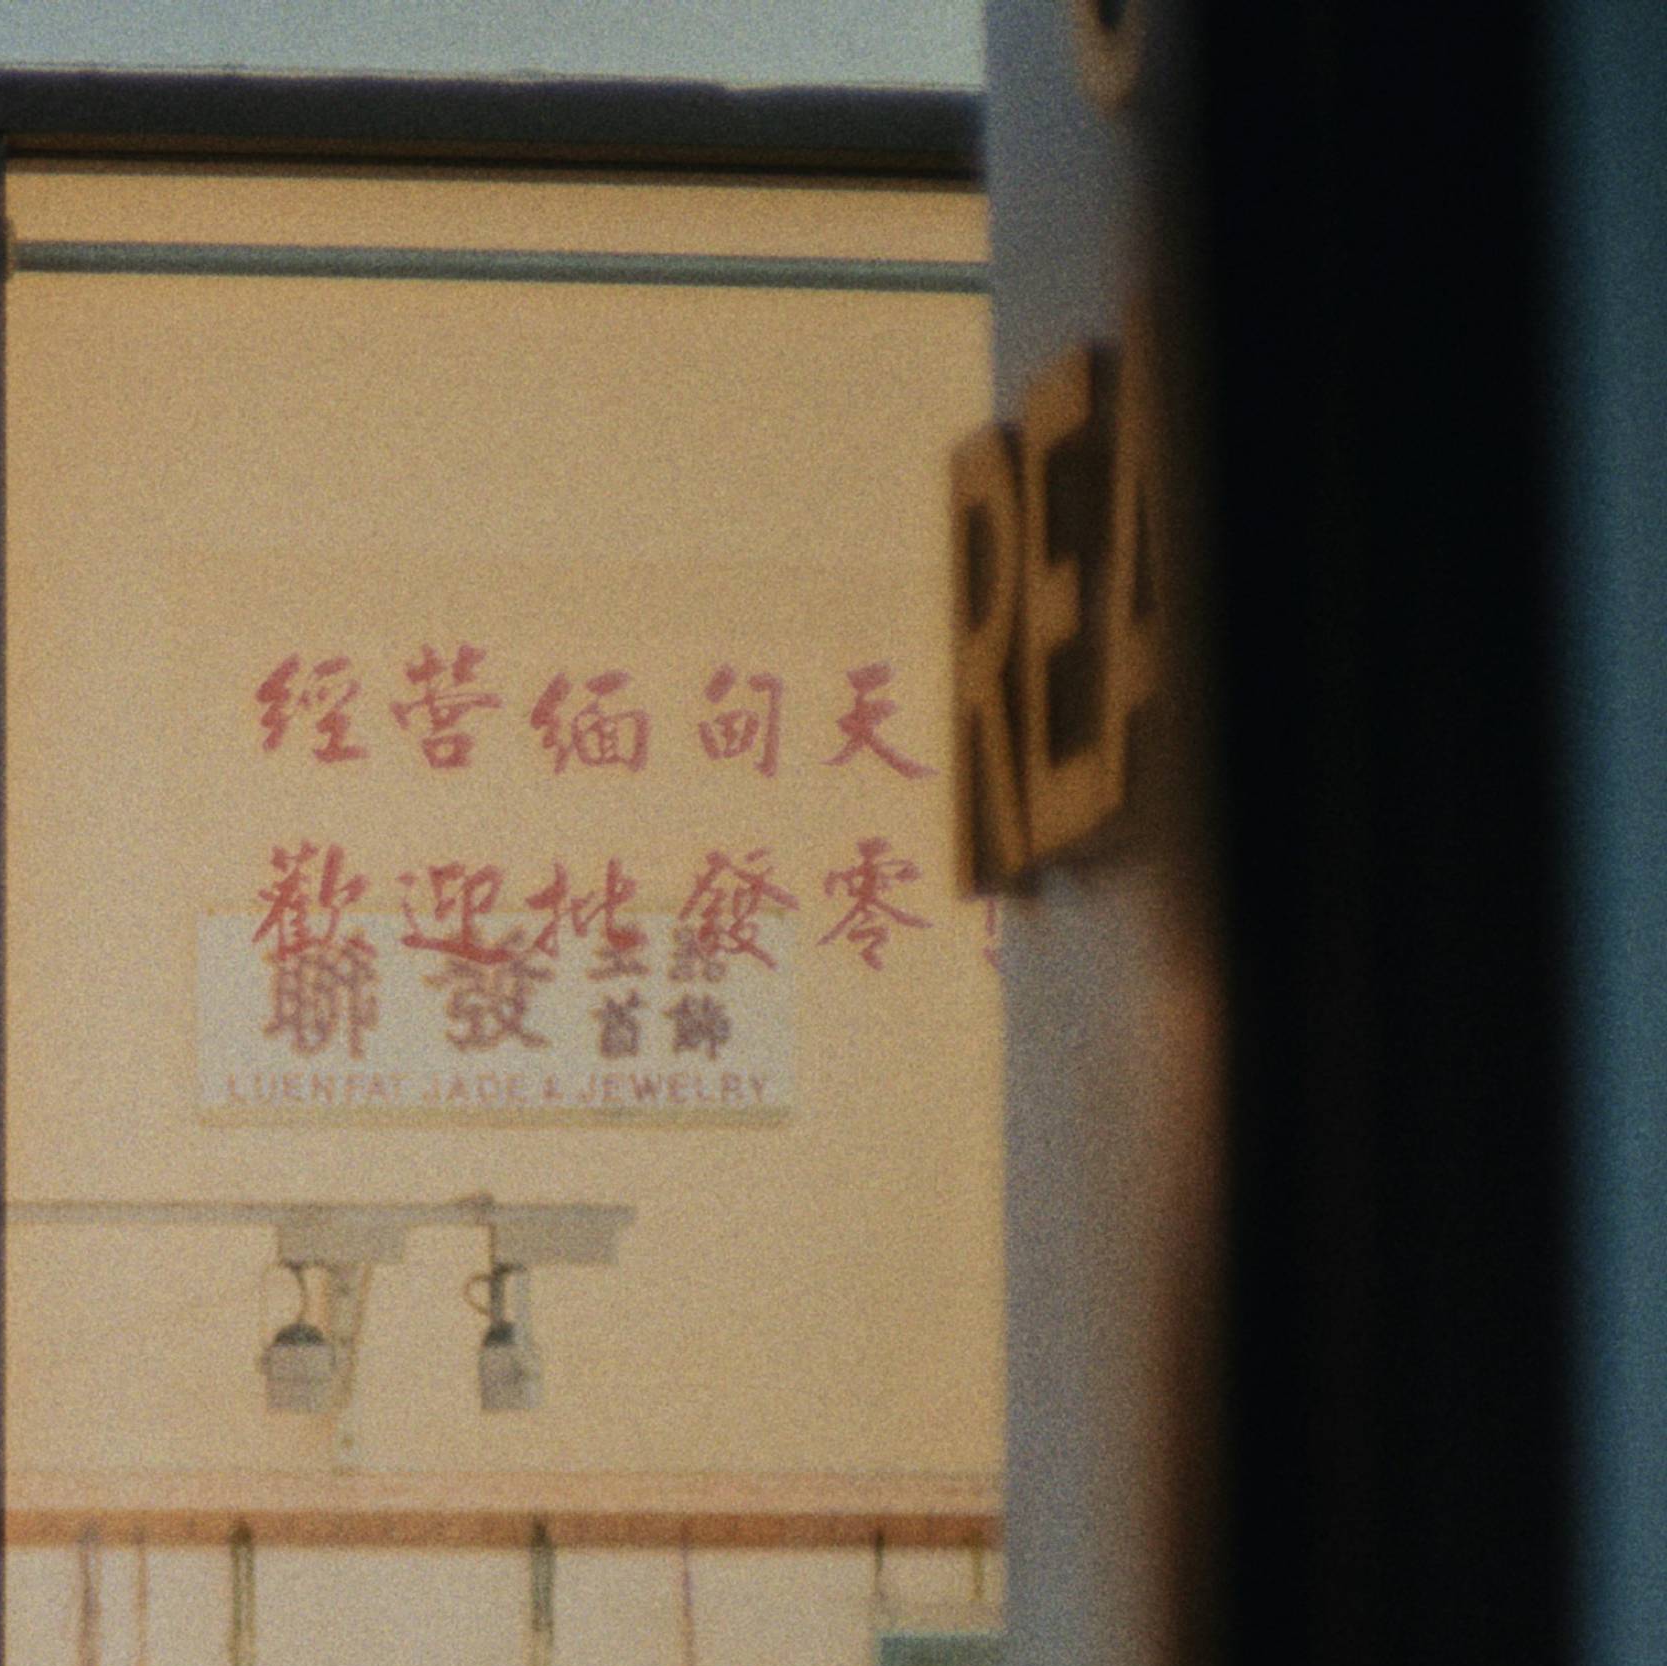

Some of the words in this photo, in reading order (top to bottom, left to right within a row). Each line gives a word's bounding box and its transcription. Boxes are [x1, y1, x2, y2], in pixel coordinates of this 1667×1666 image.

[252, 836, 1005, 975] 歡迎批發零
[425, 1073, 526, 1102] JADE
[576, 1072, 772, 1103] JEWELRY
